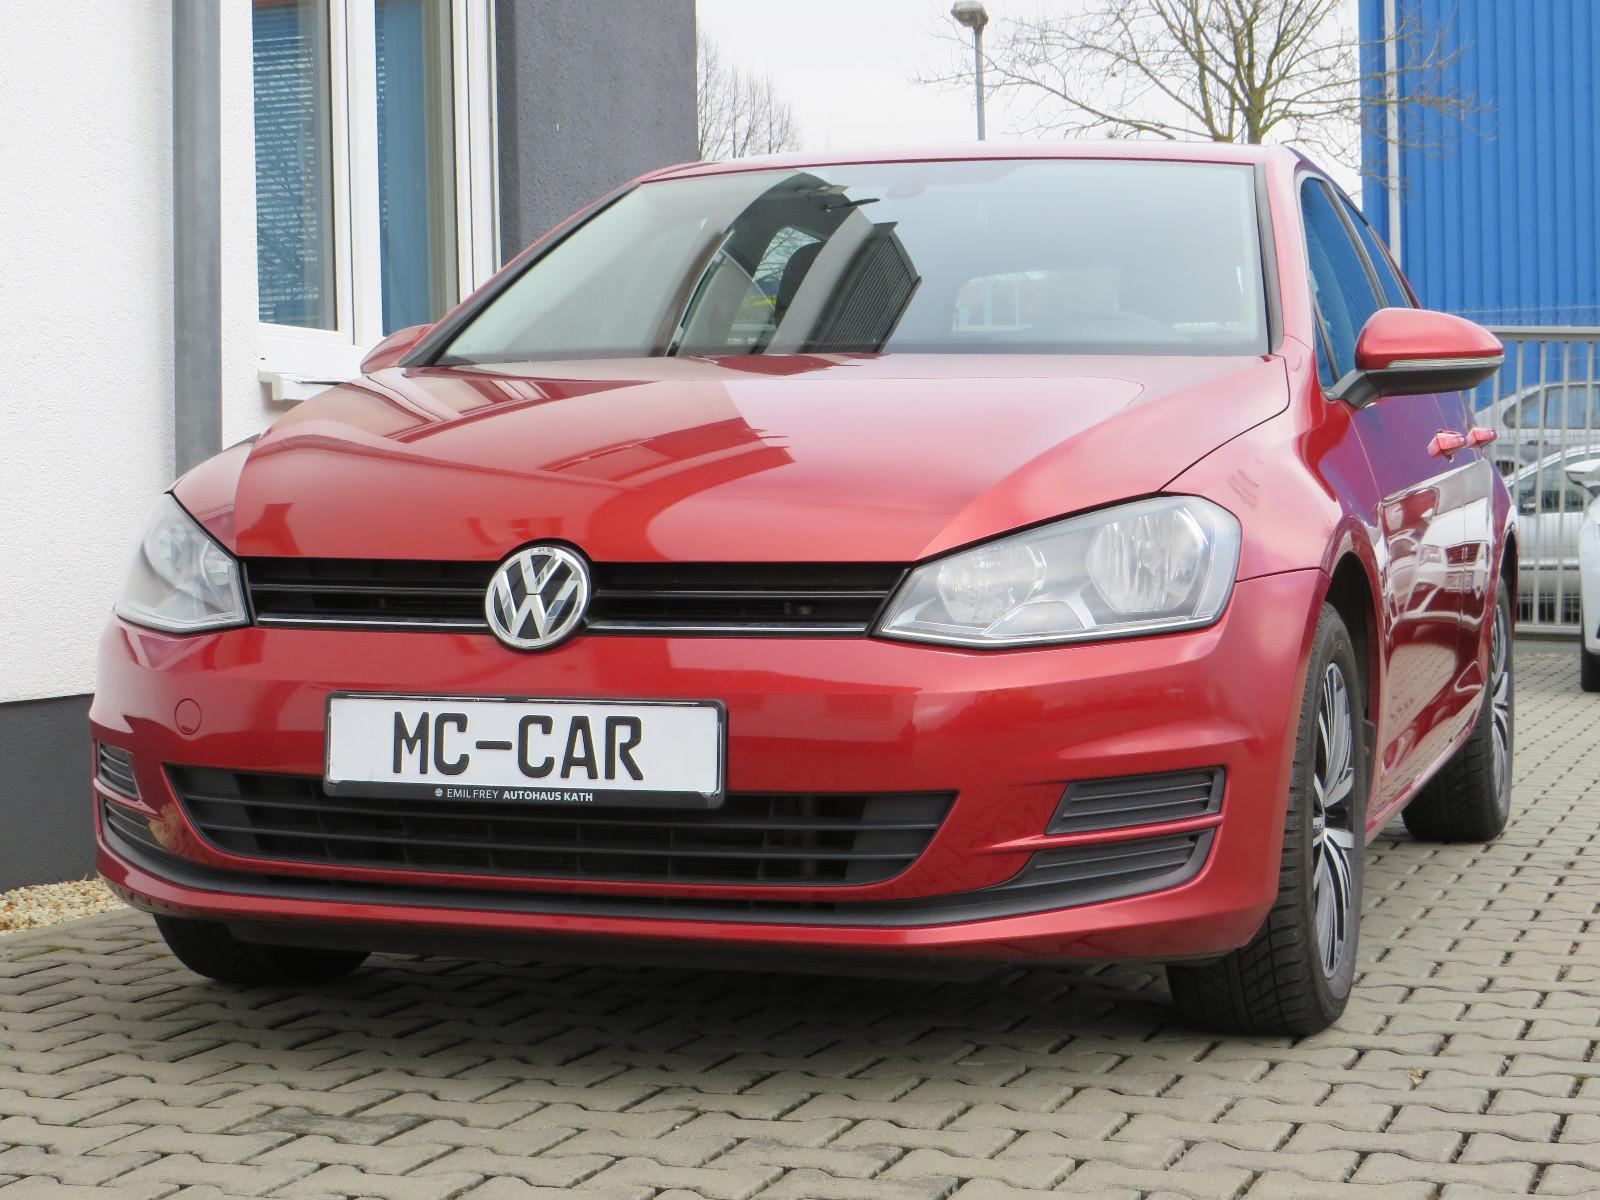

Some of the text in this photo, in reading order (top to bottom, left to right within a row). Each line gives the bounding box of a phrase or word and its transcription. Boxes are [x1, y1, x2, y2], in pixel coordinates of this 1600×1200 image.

[487, 548, 589, 649] VW
[392, 711, 645, 781] MC-CAR
[447, 788, 593, 802] EMIL FREY AUTOHAUS KATH
